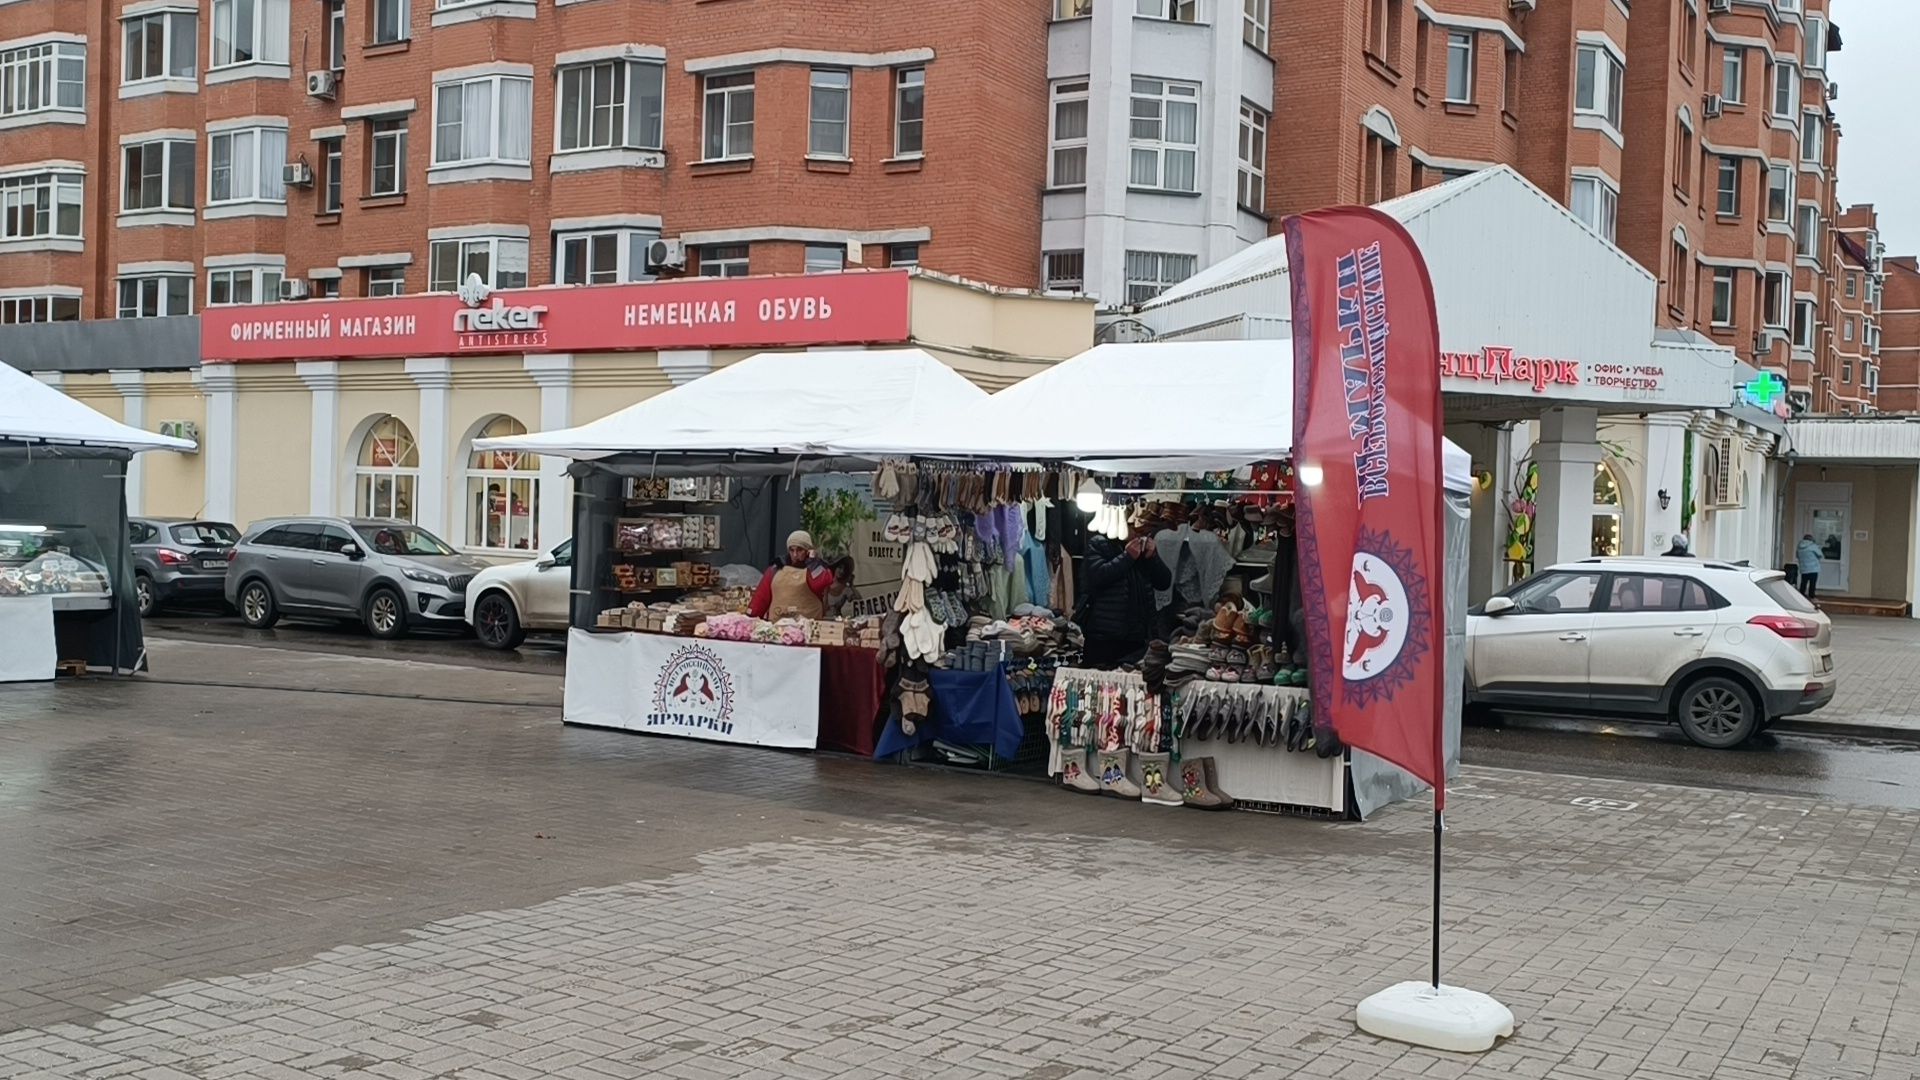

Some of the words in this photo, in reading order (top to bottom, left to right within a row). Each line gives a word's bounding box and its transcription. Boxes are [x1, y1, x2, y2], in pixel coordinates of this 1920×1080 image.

[453, 298, 548, 332] neker
[624, 300, 736, 328] НЕМЕЦКАЯ
[758, 296, 832, 321] ОБУВЬ
[231, 313, 331, 341] ФИРМЕННЫЙ
[340, 315, 416, 338] МАГАЗИН
[459, 332, 548, 346] ANTISTRESS
[1440, 344, 1579, 393] нцПарк
[1594, 363, 1623, 374] ОФИС
[1632, 365, 1664, 376] УЧЕБА
[1594, 376, 1657, 389] ТВОРЧЕСТВО
[869, 546, 893, 558] БУДЕТЕ
[647, 713, 734, 735] ЯРМАРКИ
